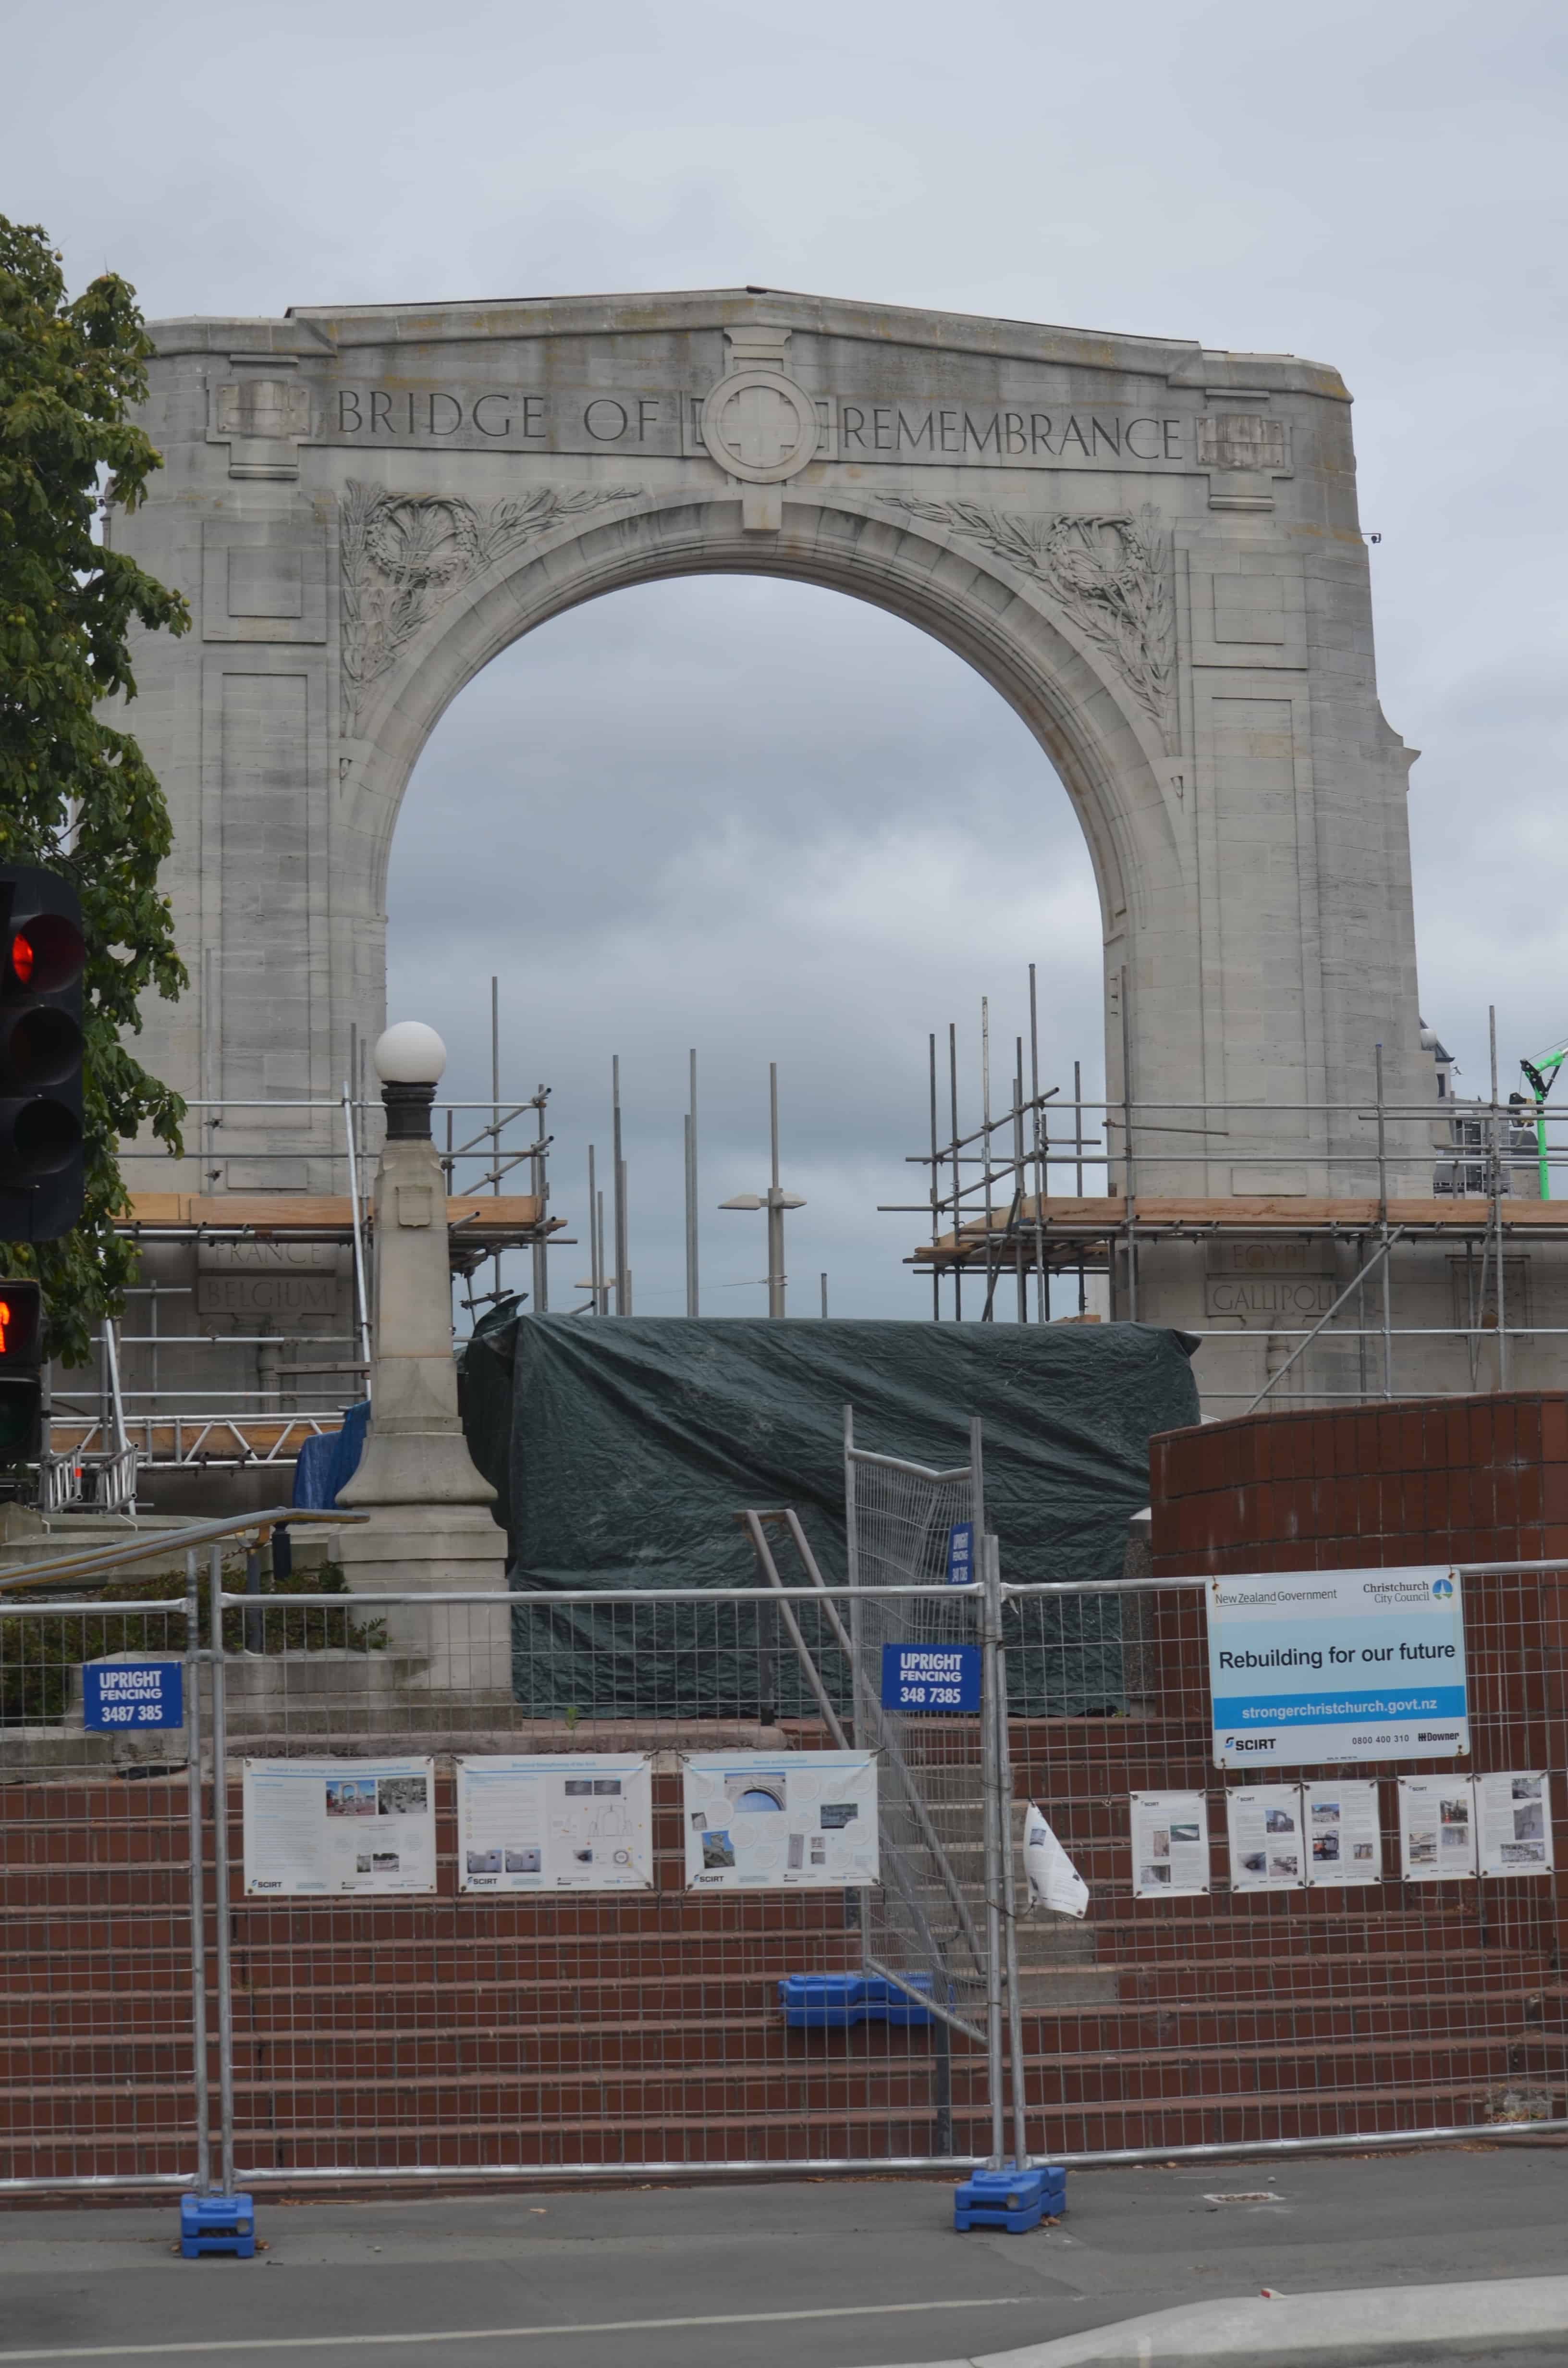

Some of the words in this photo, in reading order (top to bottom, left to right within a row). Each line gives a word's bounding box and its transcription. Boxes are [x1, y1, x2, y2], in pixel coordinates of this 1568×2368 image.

[338, 390, 546, 438] BRIDGE
[584, 399, 659, 442] OF
[843, 407, 1183, 459] REMEMBRANCE
[216, 1243, 322, 1263] FRANCE
[1233, 1245, 1311, 1268] EGYPT
[207, 1281, 328, 1307] BELGIUM
[1363, 1581, 1429, 1593] Christchurch
[1215, 1594, 1237, 1604] New
[1238, 1591, 1276, 1603] Zealand
[1277, 1589, 1337, 1601] Government
[1374, 1593, 1392, 1604] City
[1395, 1591, 1430, 1602] Council
[900, 1653, 963, 1670] UPRIGHT
[1219, 1648, 1323, 1669] Rebuilding
[1328, 1646, 1356, 1664] for
[1361, 1647, 1394, 1662] our
[1399, 1642, 1456, 1660] future
[99, 1670, 162, 1689] UPRIGHT
[899, 1670, 962, 1683] FENCING
[99, 1689, 163, 1701] FENCING
[900, 1687, 925, 1703] 348
[929, 1688, 961, 1703] 7385
[101, 1705, 135, 1722] 3487
[137, 1704, 163, 1721] 385
[1241, 1698, 1438, 1721] strongerchristchurch.govt.nz
[1235, 1738, 1276, 1751] SCIRT
[1352, 1736, 1372, 1745] 0800
[1394, 1734, 1409, 1742] 310
[1427, 1732, 1459, 1741] Downer
